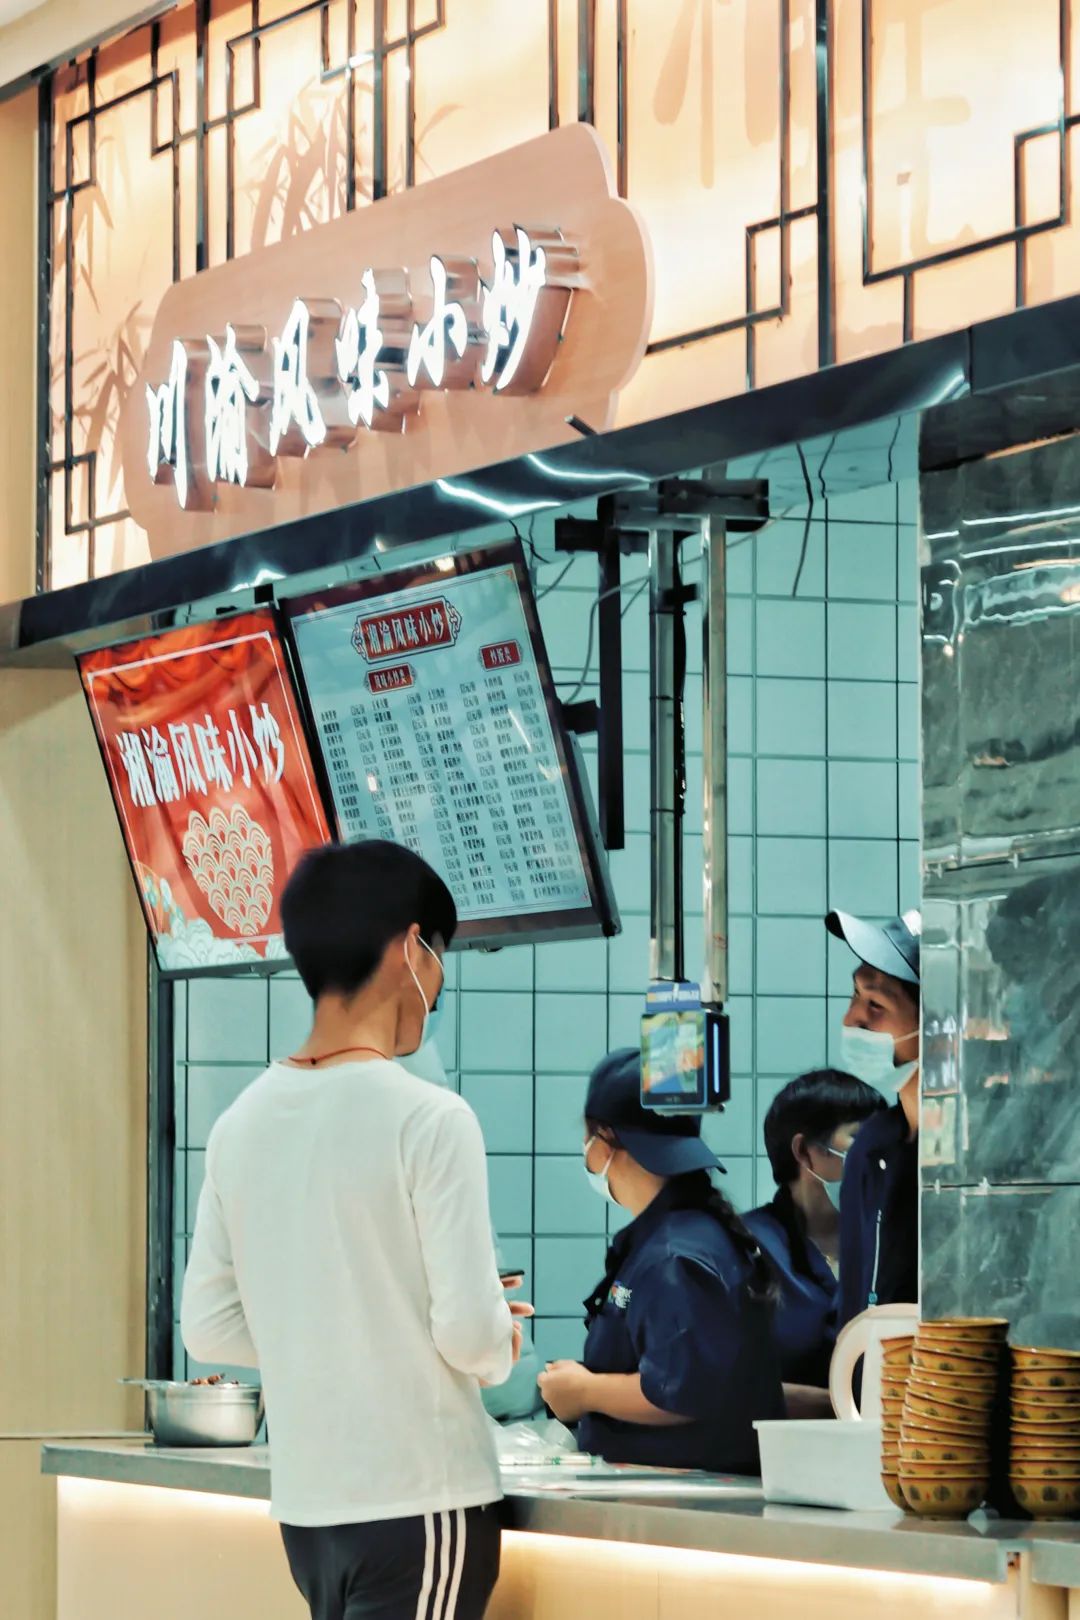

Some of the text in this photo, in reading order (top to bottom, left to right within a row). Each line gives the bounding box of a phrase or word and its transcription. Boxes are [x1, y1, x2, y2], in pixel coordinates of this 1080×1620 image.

[146, 223, 546, 510] 川渝风味小炒
[115, 702, 285, 807] 湘渝风味小炒
